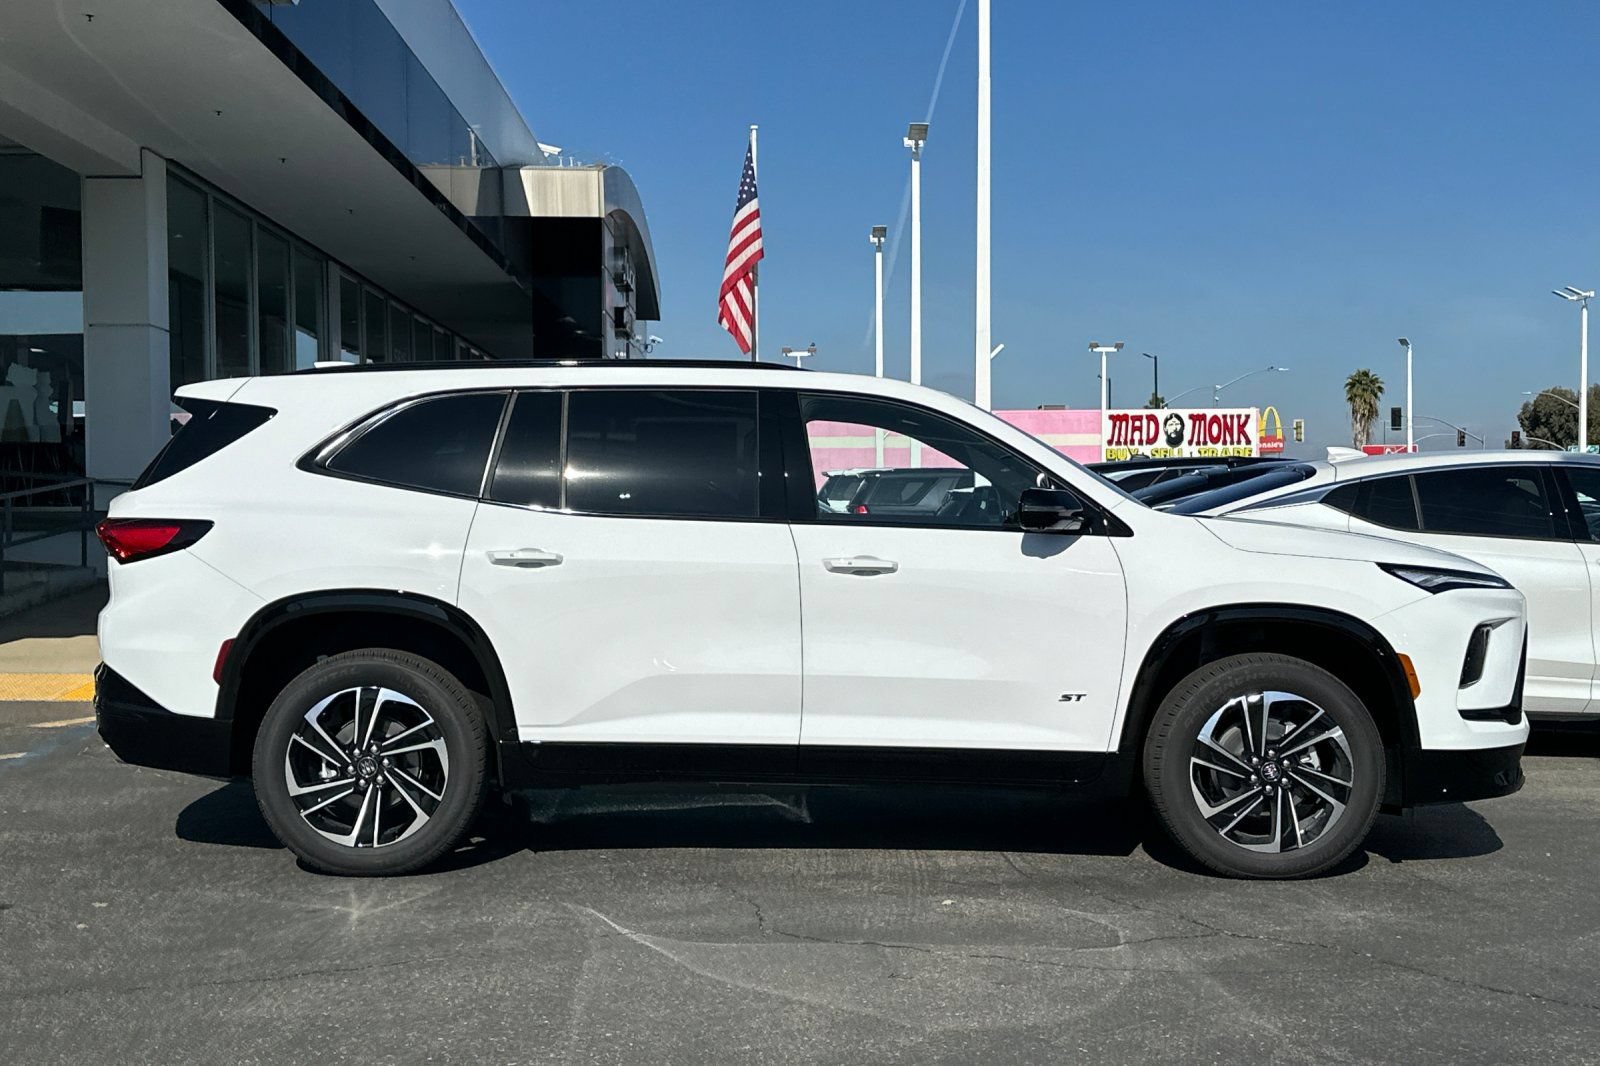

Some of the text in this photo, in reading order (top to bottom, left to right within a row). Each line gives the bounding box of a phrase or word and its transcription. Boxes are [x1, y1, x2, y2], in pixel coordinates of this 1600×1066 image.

[1107, 413, 1252, 447] MAD MONK
[1198, 447, 1253, 457] TRADE
[1058, 694, 1087, 702] ST
